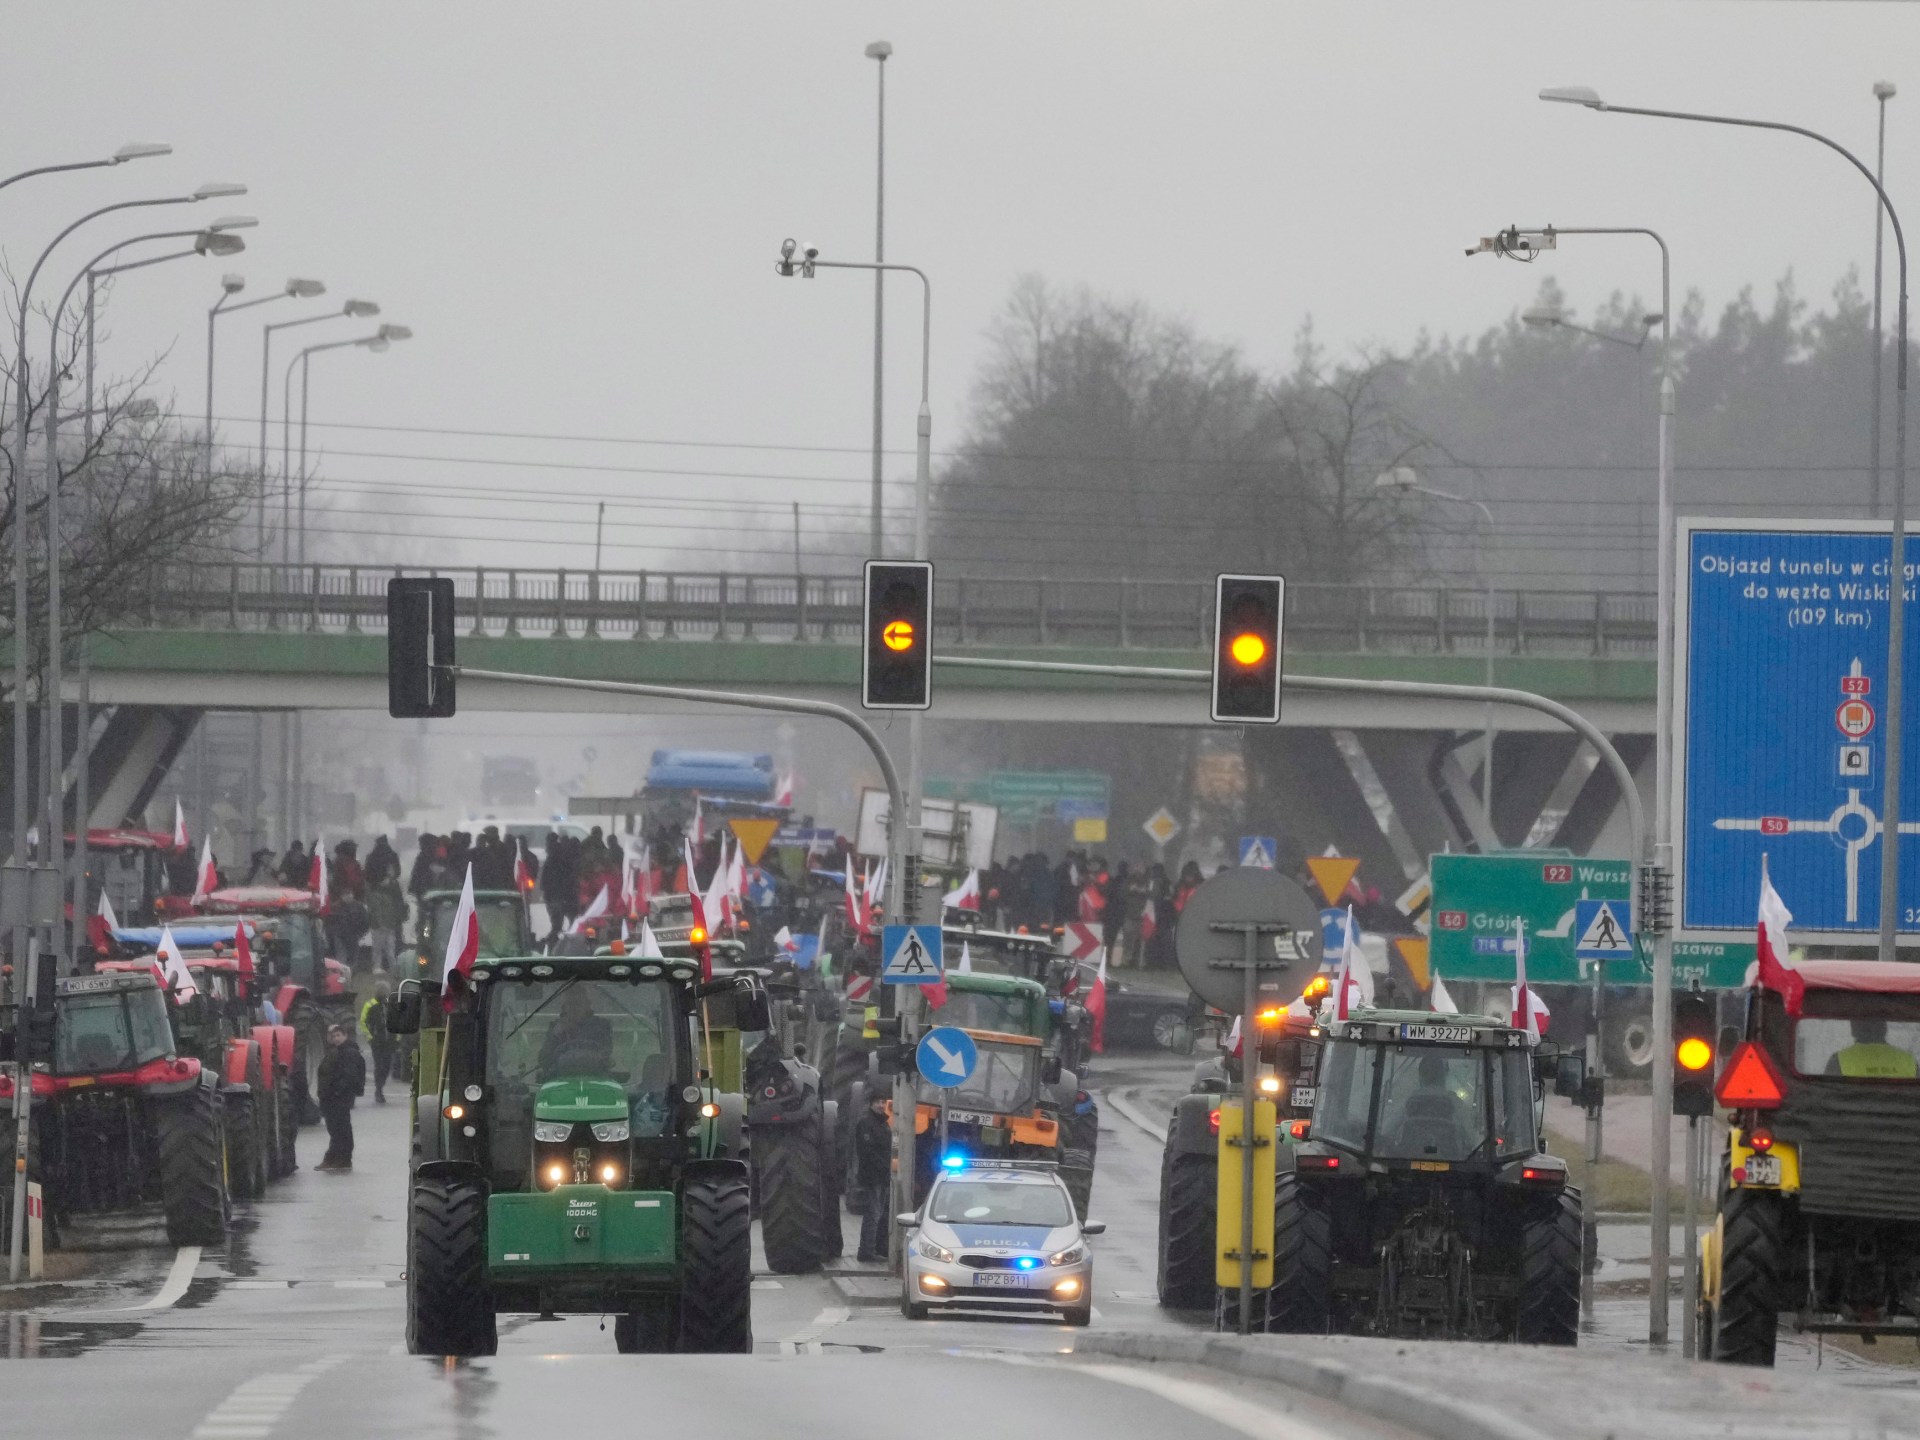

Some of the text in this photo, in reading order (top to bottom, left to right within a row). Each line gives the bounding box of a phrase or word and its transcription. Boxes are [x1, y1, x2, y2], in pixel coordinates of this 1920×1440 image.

[1700, 555, 1920, 581] Objazd tunelu w cig
[1743, 582, 1916, 604] do węzła Wiskiki
[1787, 607, 1873, 629] (109 km)
[1847, 680, 1864, 692] S2
[1549, 867, 1632, 883] 92 Warsz
[1472, 912, 1530, 933] Grójec
[1639, 937, 1725, 957] Wszawa
[1409, 1025, 1468, 1040] WM 3927P
[950, 1111, 962, 1121] WM
[974, 1239, 1030, 1248] POLICJA
[980, 1274, 1026, 1285] HPZ B911
